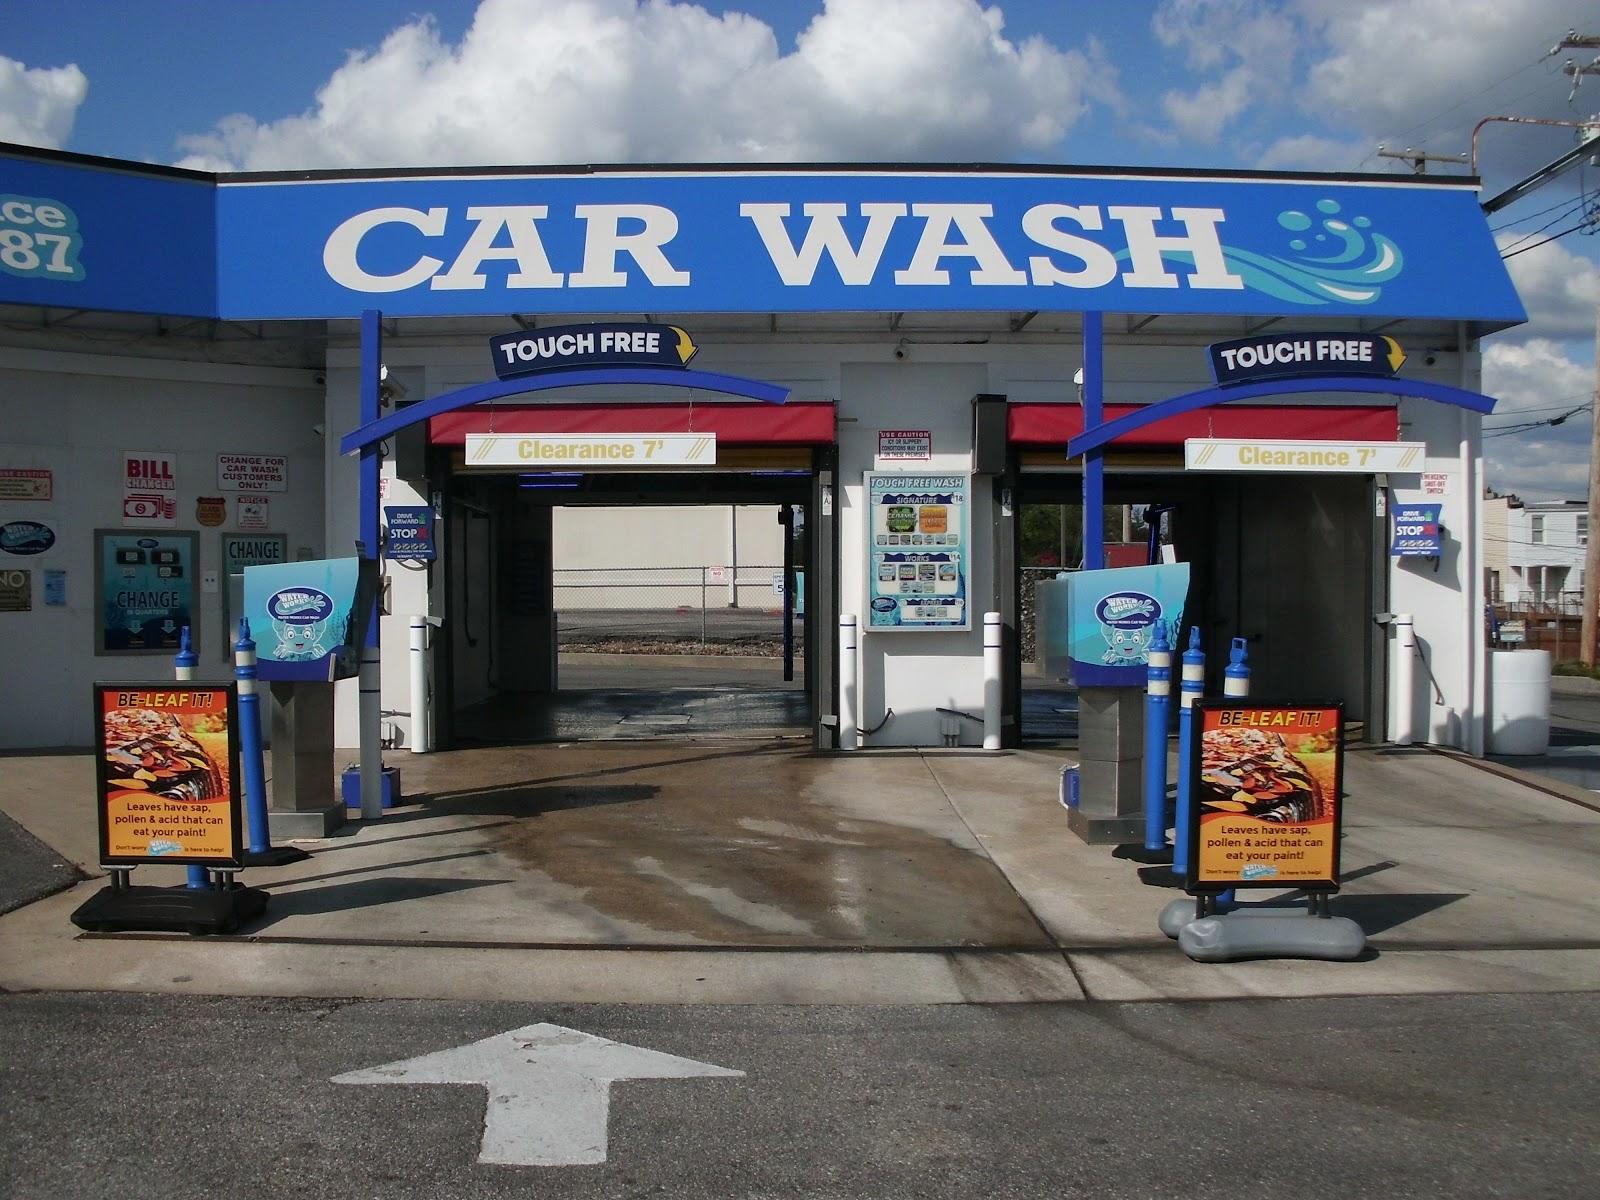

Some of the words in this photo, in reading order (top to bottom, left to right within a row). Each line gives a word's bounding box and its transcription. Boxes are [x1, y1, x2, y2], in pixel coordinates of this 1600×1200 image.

[0, 201, 66, 228] ce
[323, 204, 690, 293] CAR
[739, 202, 1244, 290] WASH
[500, 333, 594, 364] TOUCH
[600, 332, 660, 353] FREE
[1220, 341, 1311, 371] TOUCH
[1316, 340, 1372, 362] FREE
[518, 440, 635, 459] Clearance
[220, 456, 262, 465] CHANGE
[265, 457, 284, 466] FOR
[1238, 447, 1349, 466] Clearance
[127, 459, 173, 479] BILL
[222, 473, 282, 482] CUSTOMERS
[126, 479, 175, 490] CHANGER
[238, 481, 268, 489] ONLY!
[871, 478, 905, 488] TOUCH
[908, 478, 932, 487] FREE
[933, 478, 963, 487] WASH
[391, 529, 417, 538] STOP
[1397, 526, 1424, 536] STOP
[229, 541, 280, 559] CHANGE
[117, 591, 179, 608] CHANGE
[277, 593, 309, 602] WATER
[1106, 598, 1138, 607] WATER
[118, 693, 189, 707] BE-LEAF
[191, 693, 213, 708] IT!
[1219, 711, 1296, 726] BE-LEAF
[1299, 711, 1322, 727] IT!
[127, 803, 161, 811] Leaves
[164, 803, 188, 812] have
[191, 804, 211, 814] sap,
[115, 815, 146, 825] pollen
[159, 815, 179, 824] acid
[182, 815, 202, 824] that
[205, 817, 223, 825] can
[152, 829, 174, 838] your
[177, 828, 206, 838] paint!
[1221, 826, 1258, 834] Leaves
[1261, 826, 1287, 834] have
[1207, 838, 1240, 848] pollen
[1244, 839, 1251, 847] &
[1255, 838, 1276, 847] acid
[1280, 839, 1301, 847] that
[1226, 852, 1244, 860] eat
[1246, 853, 1271, 862] your
[1273, 852, 1304, 862] paint!
